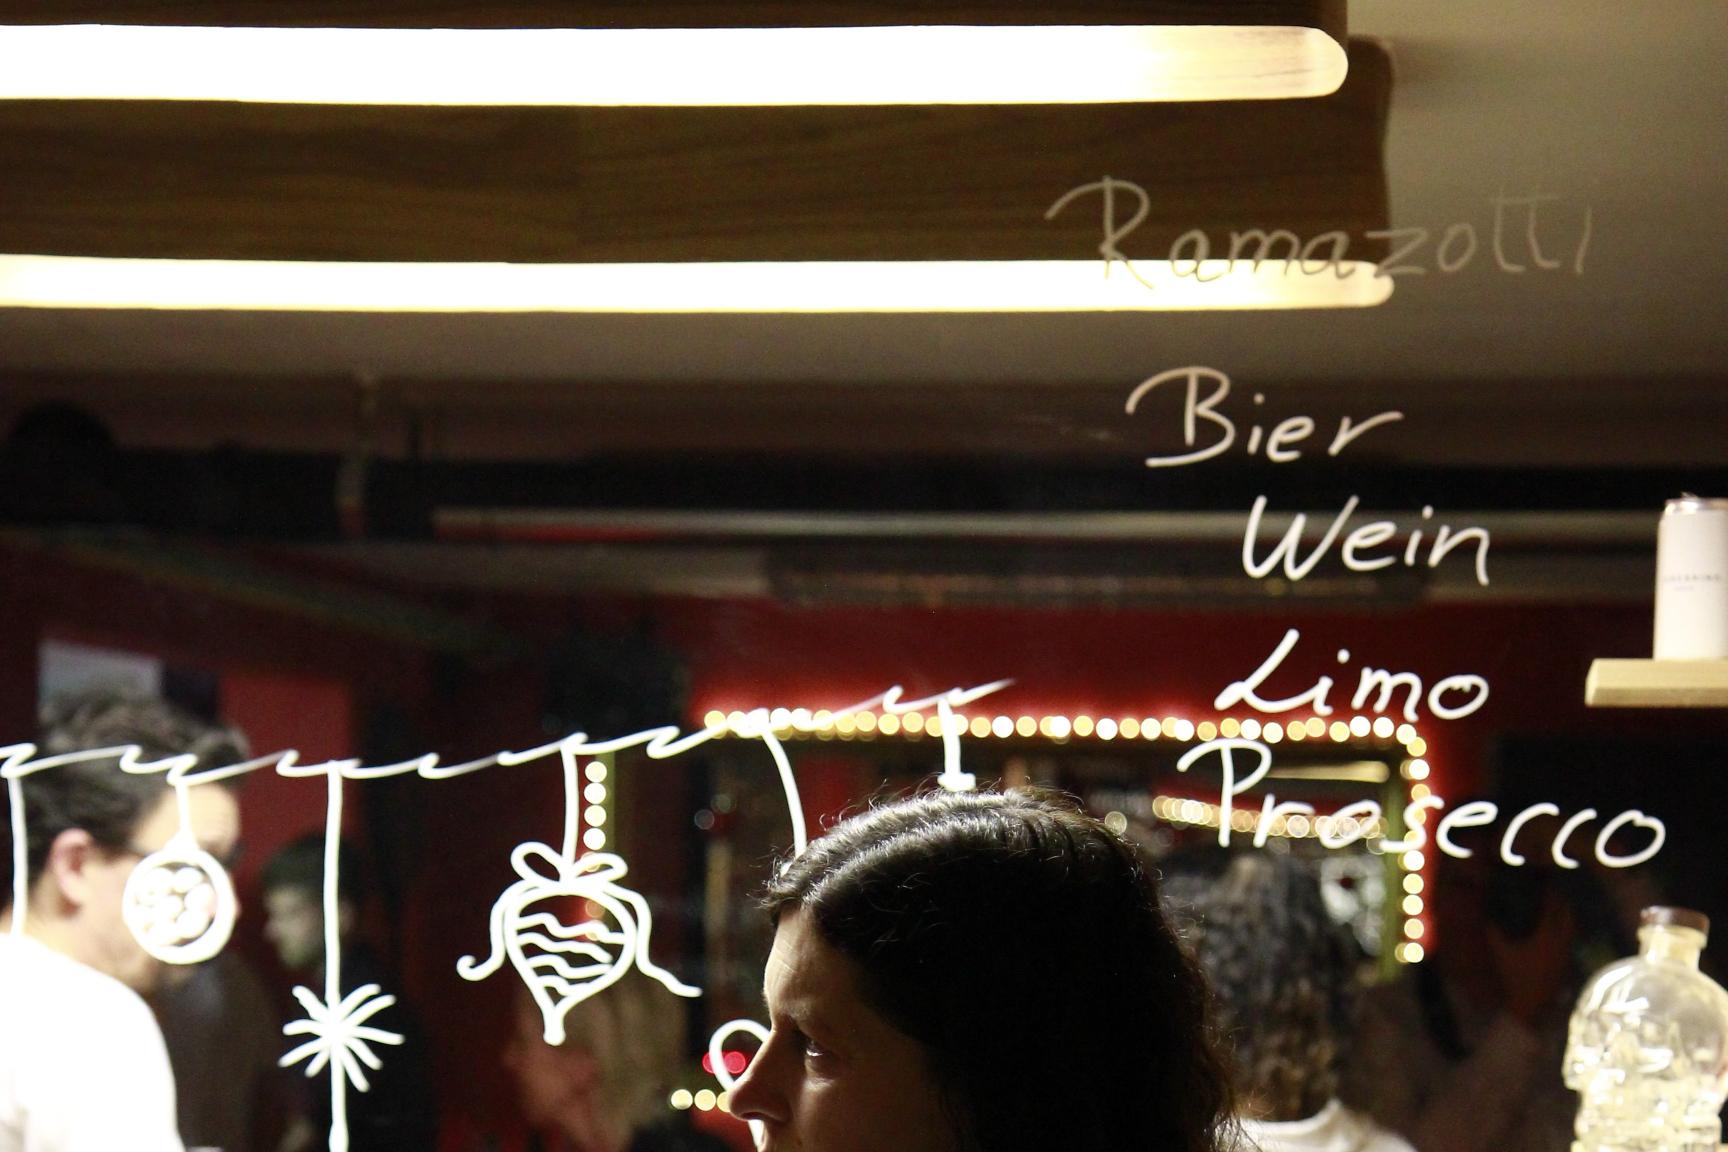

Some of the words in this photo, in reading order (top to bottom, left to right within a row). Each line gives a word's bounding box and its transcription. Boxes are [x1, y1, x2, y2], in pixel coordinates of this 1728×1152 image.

[1044, 174, 1594, 291] Ramazotti
[1125, 366, 1405, 469] Bier
[1242, 495, 1491, 587] Wein
[1213, 628, 1490, 723] Limo
[1176, 738, 1667, 869] Prosecco
